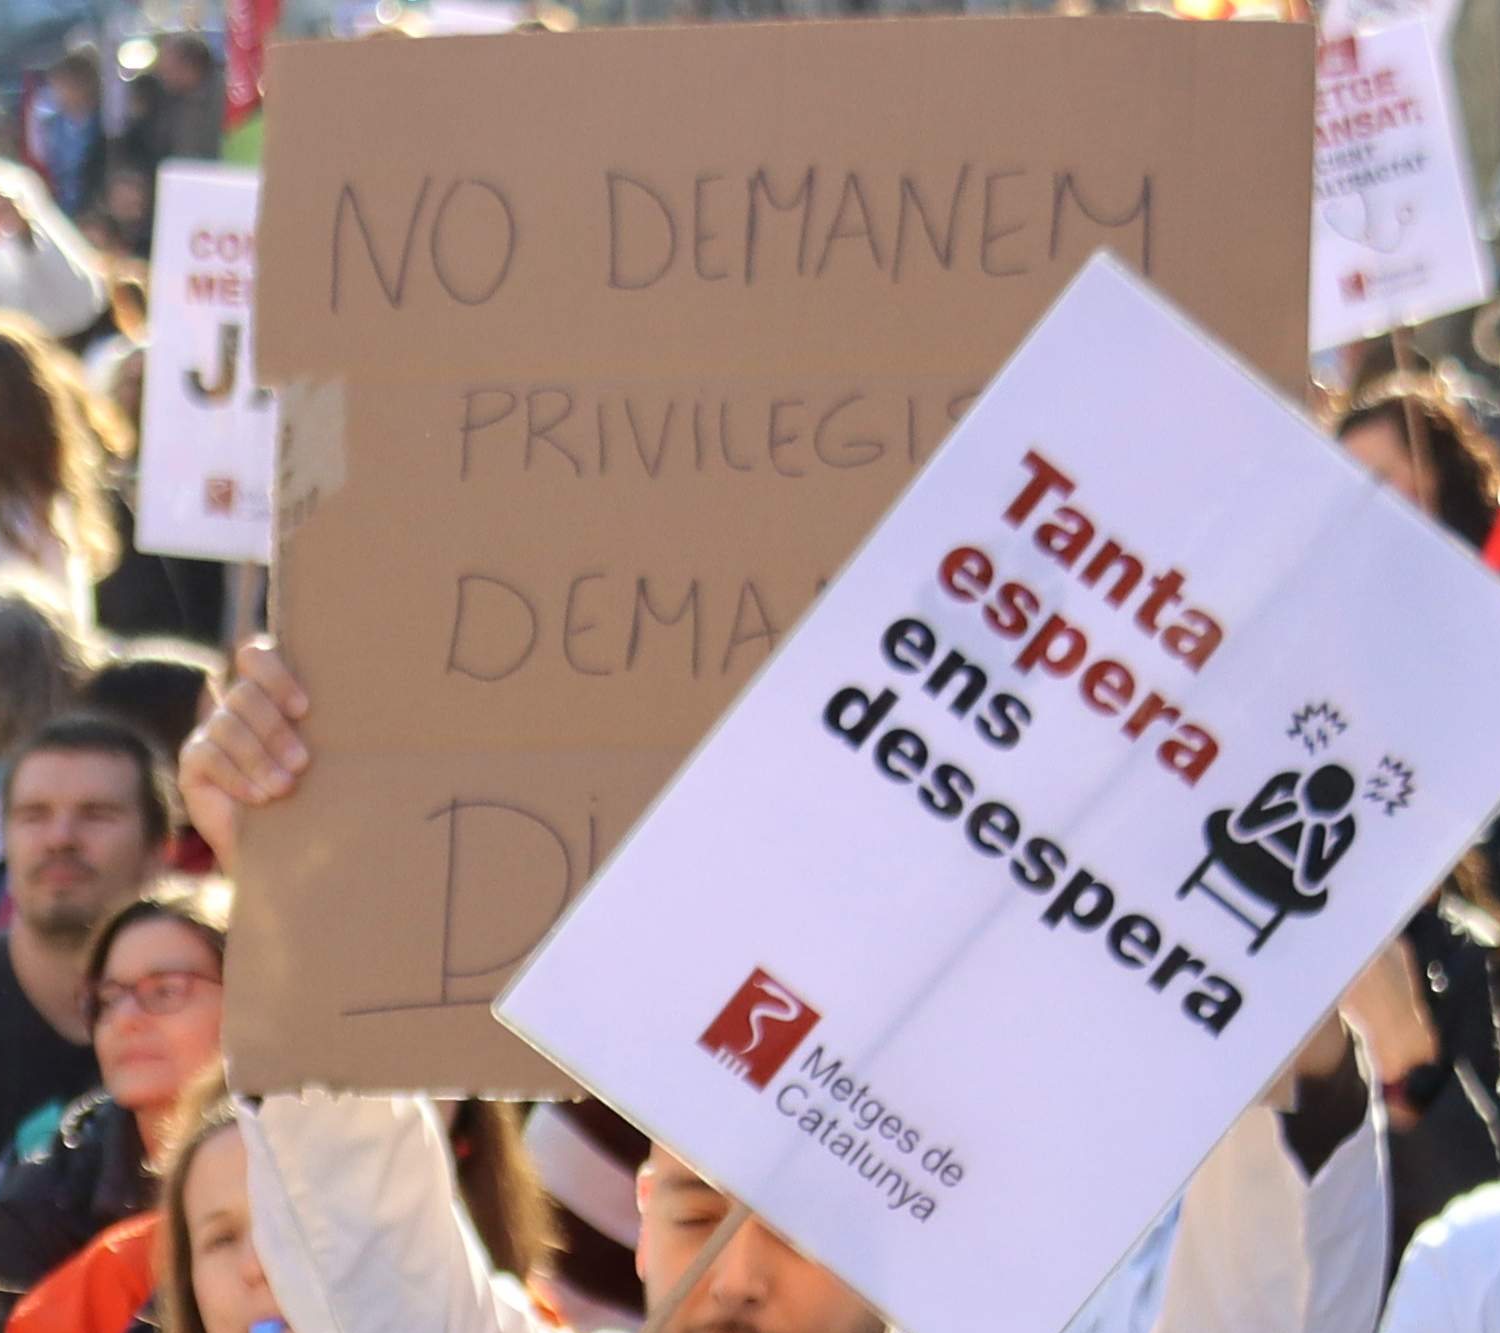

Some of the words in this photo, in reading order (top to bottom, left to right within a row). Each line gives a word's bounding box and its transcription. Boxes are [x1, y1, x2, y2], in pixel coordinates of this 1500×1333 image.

[328, 172, 519, 316] NO
[604, 162, 1157, 293] DEMANEM
[445, 572, 832, 682] DEMA
[999, 448, 1226, 674] Tanta
[880, 612, 1033, 751] ens
[936, 542, 1222, 788] espera
[822, 683, 1245, 1038] desespera
[775, 1083, 938, 1223] Catalunya
[800, 1045, 920, 1154] Metges
[921, 1147, 964, 1188] de
